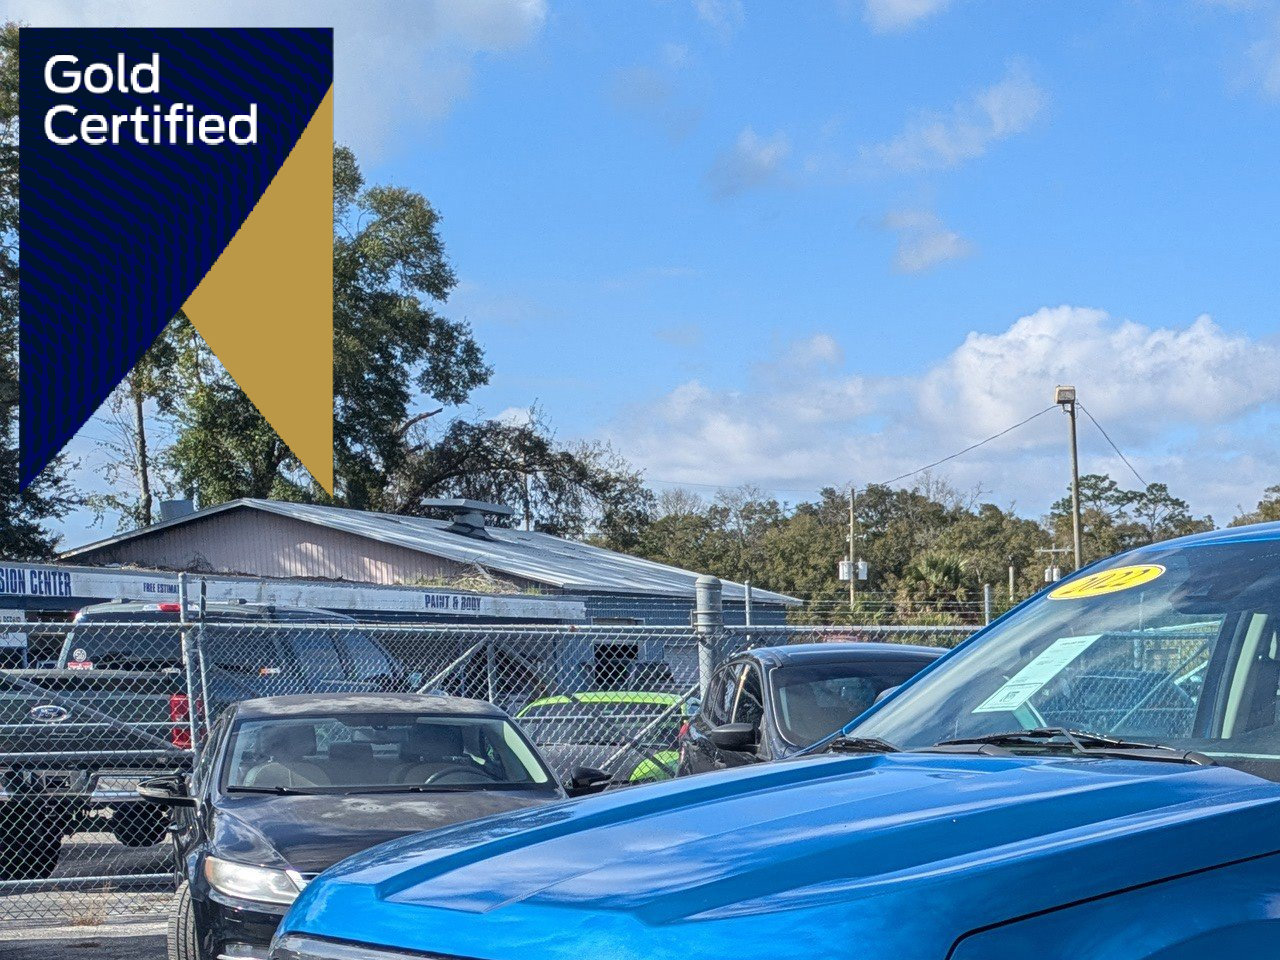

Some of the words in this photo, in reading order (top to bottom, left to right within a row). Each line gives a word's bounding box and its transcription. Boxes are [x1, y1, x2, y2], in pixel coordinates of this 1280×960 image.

[30, 570, 72, 596] CENTER
[143, 582, 156, 593] FREE
[1058, 567, 1151, 596] 2022
[424, 594, 450, 610] PAINT
[452, 596, 459, 610] &
[460, 596, 482, 611] BODY
